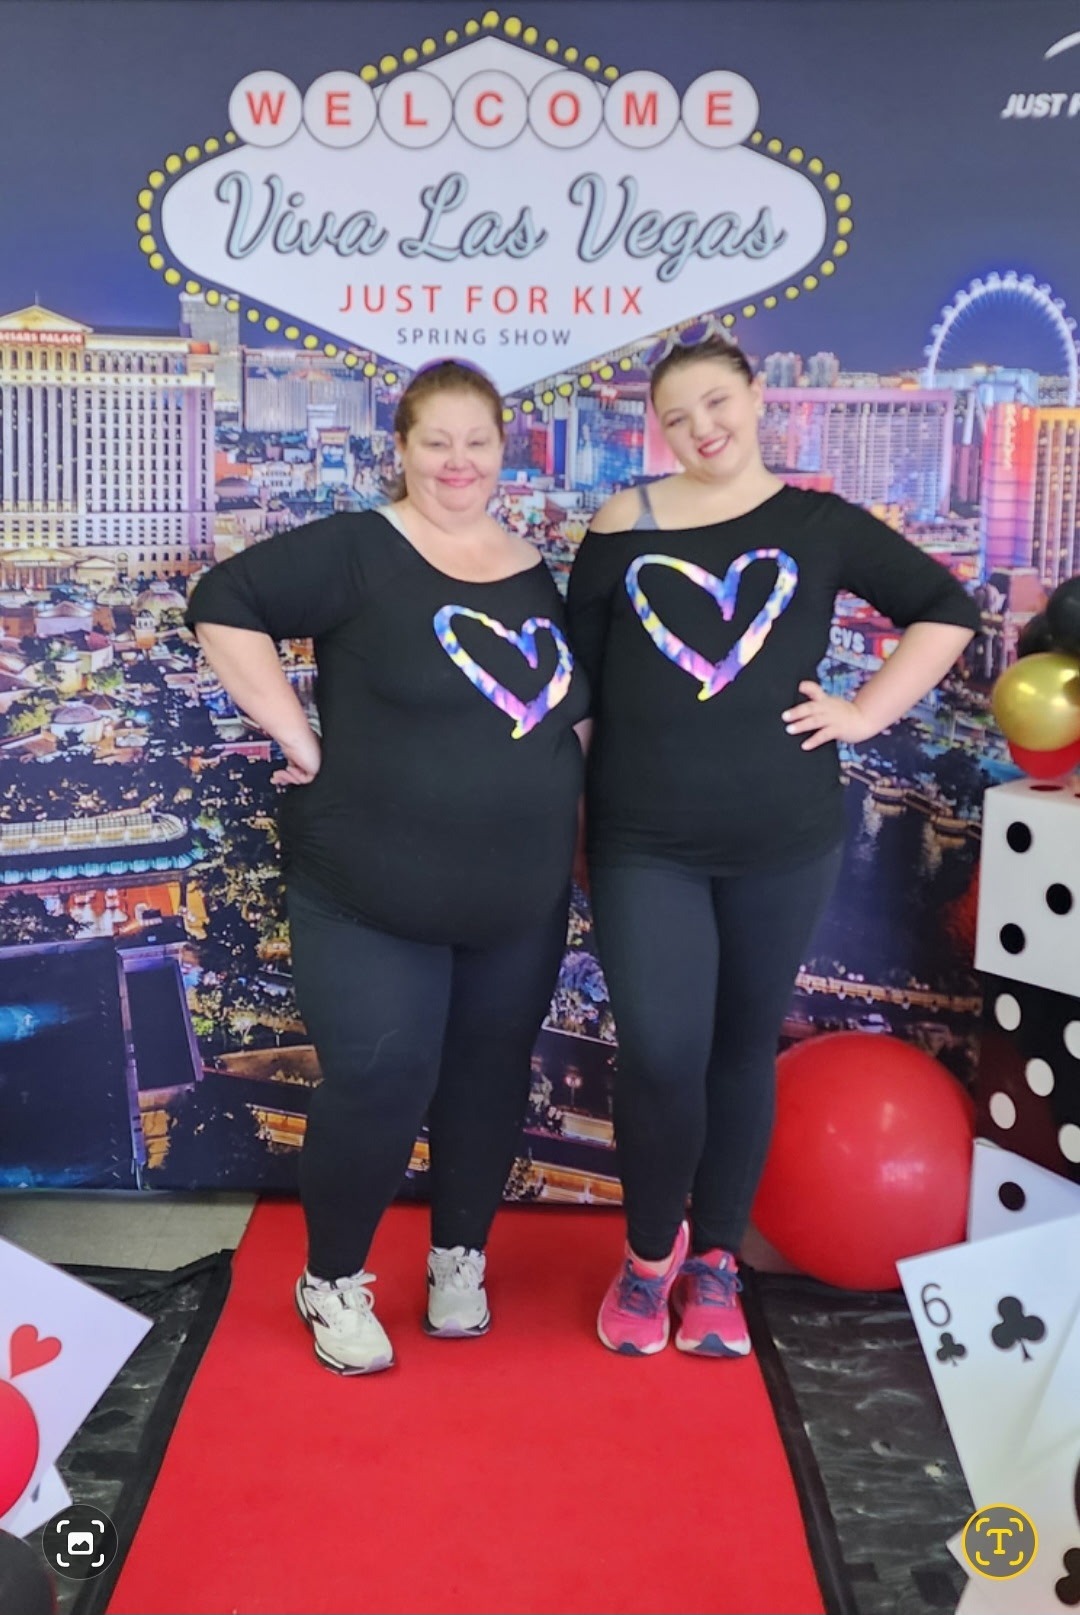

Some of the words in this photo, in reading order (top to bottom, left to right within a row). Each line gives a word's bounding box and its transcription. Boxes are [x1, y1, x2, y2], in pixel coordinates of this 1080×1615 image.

[246, 90, 733, 127] WELCOME
[1000, 92, 1068, 119] JUST
[215, 170, 389, 260] Viva
[398, 171, 548, 262] Las
[567, 171, 787, 284] Vegas
[339, 285, 440, 315] JUST
[465, 285, 548, 315] FOR
[573, 285, 643, 315] KIX
[397, 328, 486, 346] SPRING
[499, 328, 571, 347] SHOW
[830, 625, 865, 653] CVS
[920, 1283, 951, 1327] 6
